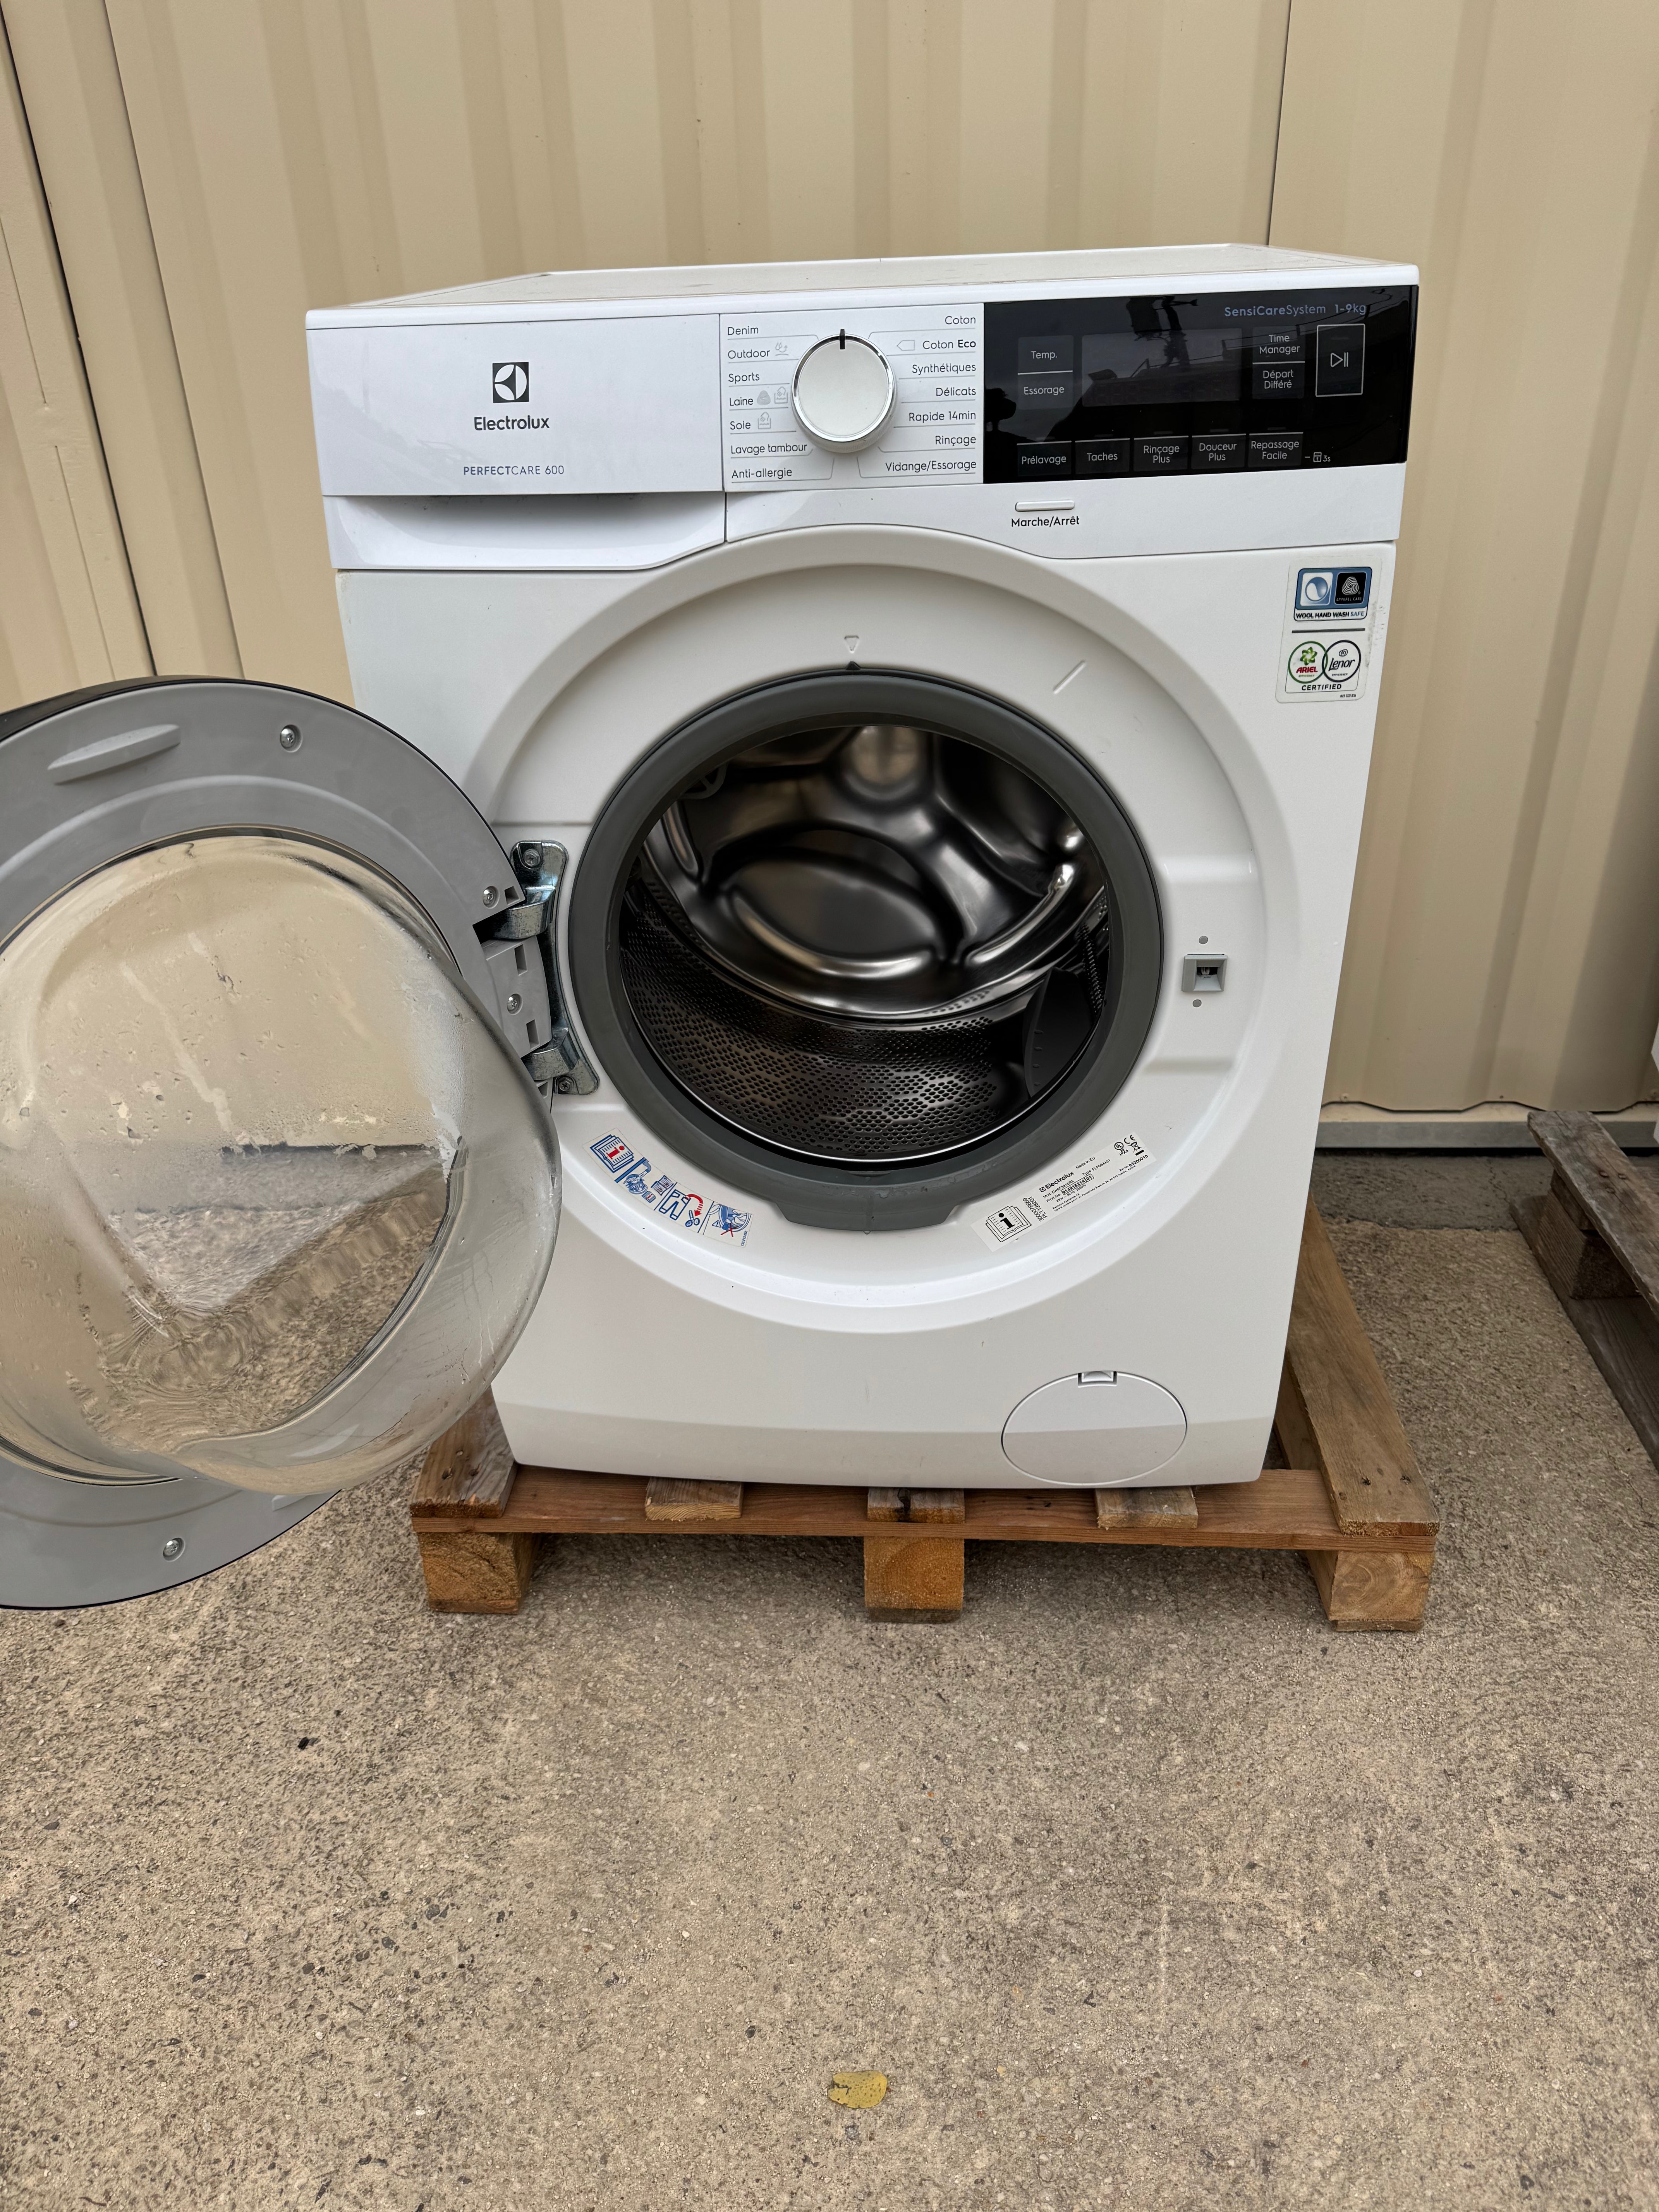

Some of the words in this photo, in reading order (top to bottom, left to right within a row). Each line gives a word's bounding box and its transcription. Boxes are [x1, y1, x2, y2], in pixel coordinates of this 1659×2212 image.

[1224, 304, 1326, 317] SensiCareSystem
[1334, 303, 1366, 315] 1-9kg
[945, 315, 976, 325] Coton
[727, 326, 759, 336] Denim
[1268, 334, 1290, 343] Time
[922, 340, 953, 349] Coton
[958, 339, 976, 348] Eco
[728, 349, 770, 359] Outdoor
[1030, 350, 1058, 360] Temp.
[1259, 345, 1300, 355] Manager
[912, 362, 976, 375] Synthétiques
[728, 372, 760, 384] Sports
[1263, 369, 1294, 380] Départ
[1264, 380, 1292, 389] Différé
[936, 386, 976, 397] Délicats
[1024, 386, 1065, 396] Essorage
[729, 397, 754, 406] Laine
[909, 411, 945, 423] Rapide
[948, 410, 976, 420] 14min
[474, 415, 550, 431] Electrolux
[730, 421, 751, 430] Soie
[935, 435, 976, 447] Rinçage
[1251, 440, 1299, 450] Repassage
[731, 445, 765, 455] Lavage
[768, 443, 807, 452] tambour
[1144, 445, 1180, 455] Rinçage
[1199, 443, 1237, 451] Douceur
[1022, 455, 1066, 465] Prélavage
[1087, 452, 1118, 461] Taches
[1153, 454, 1170, 463] Plus
[1209, 452, 1226, 461] Plus
[1262, 451, 1287, 460] Facile
[463, 465, 541, 476] PERFECTCARE
[545, 465, 564, 475] 600
[885, 460, 976, 473] Vidange/Essorage
[731, 467, 792, 479] Anti-allergie
[1011, 515, 1080, 527] Marche/Arrêt
[1328, 657, 1355, 672] Lenor
[1044, 1171, 1075, 1189] Electrolux
[1028, 1196, 1048, 1218] PLT128201
